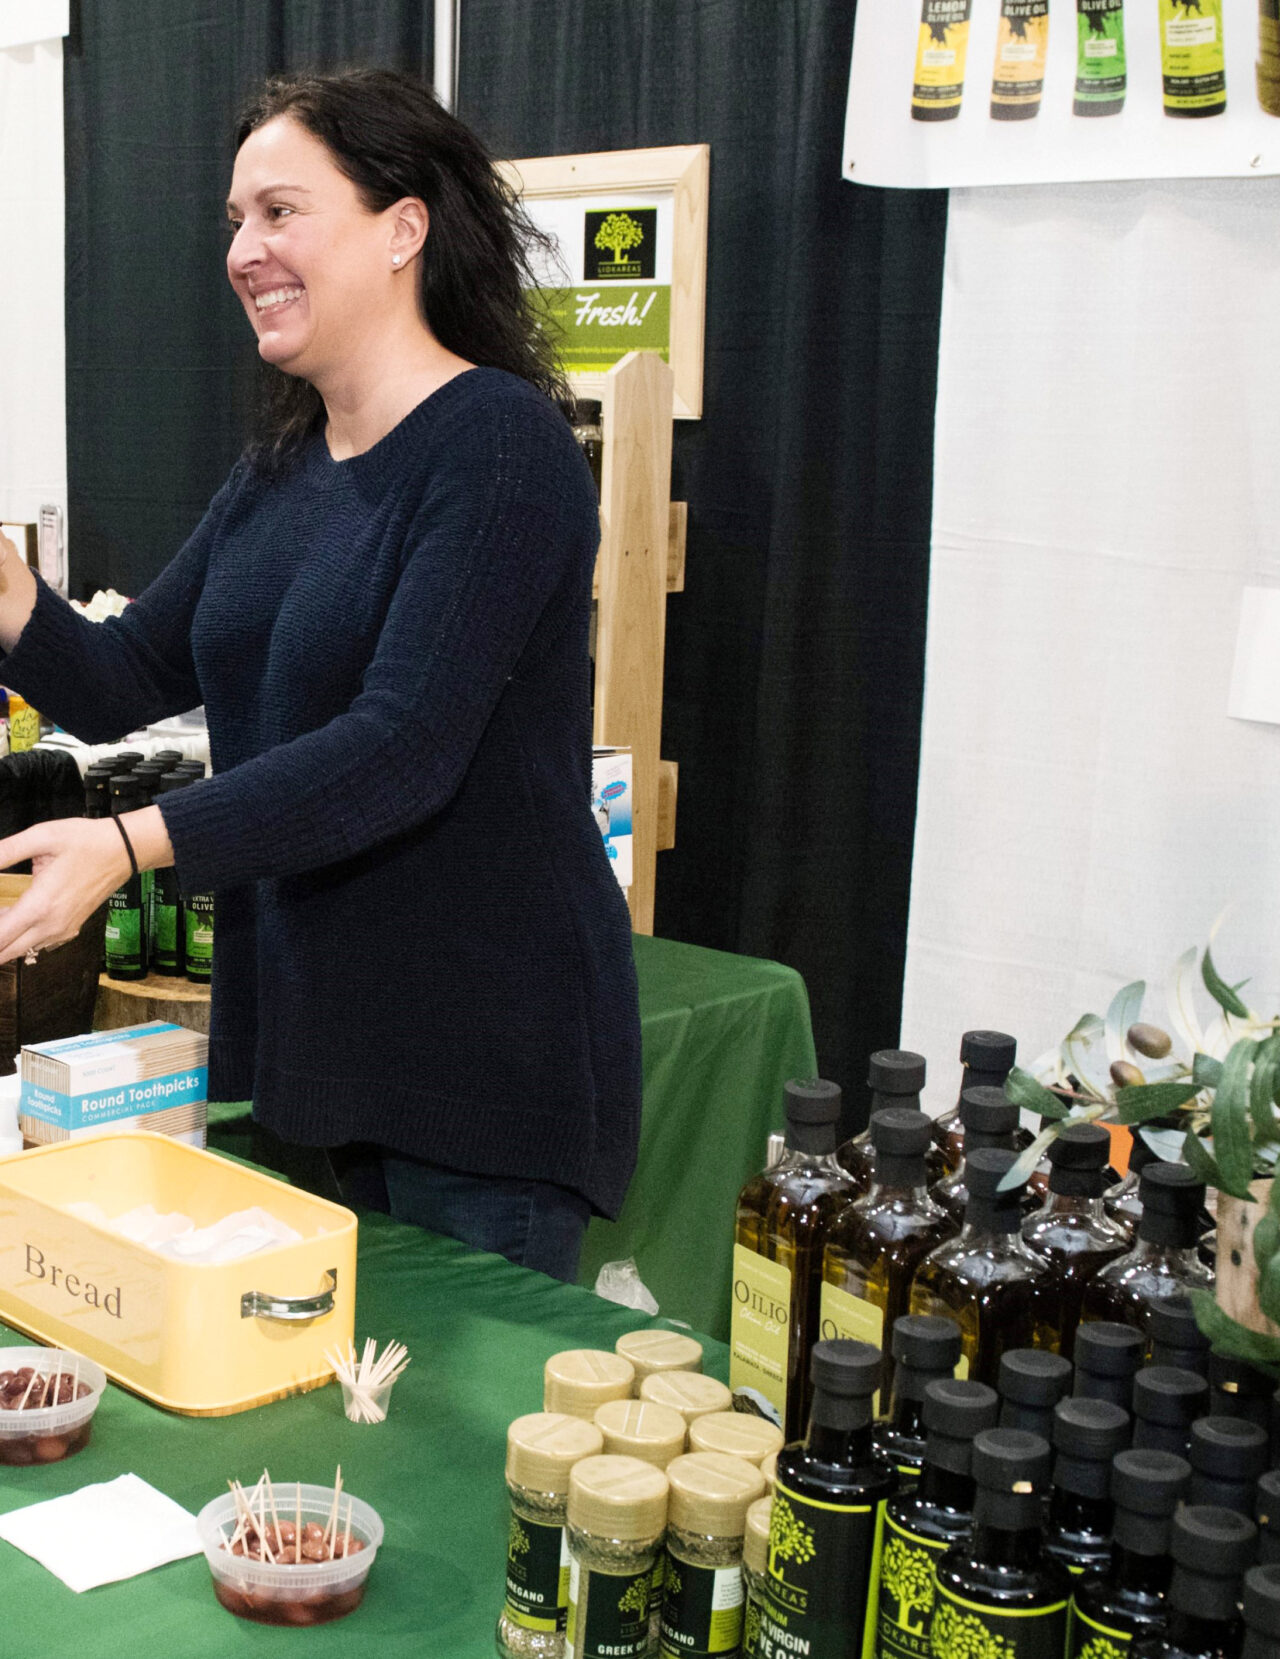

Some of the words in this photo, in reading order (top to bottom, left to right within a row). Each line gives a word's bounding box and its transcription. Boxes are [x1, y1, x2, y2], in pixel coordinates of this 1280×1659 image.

[928, 0, 967, 14] LEMON
[1004, 4, 1032, 16] OLIVE
[1033, 3, 1047, 14] OIL
[575, 292, 657, 326] Fresh!
[81, 1091, 125, 1113] Round
[128, 1075, 200, 1098] Toothpicks
[81, 1105, 134, 1122] COMMERCIAL
[23, 1242, 123, 1319] Bread
[734, 1279, 788, 1325] OILIO
[597, 1644, 634, 1656] GREEK
[768, 1620, 810, 1656] VIRGIN
[883, 1622, 929, 1654] OKARE
